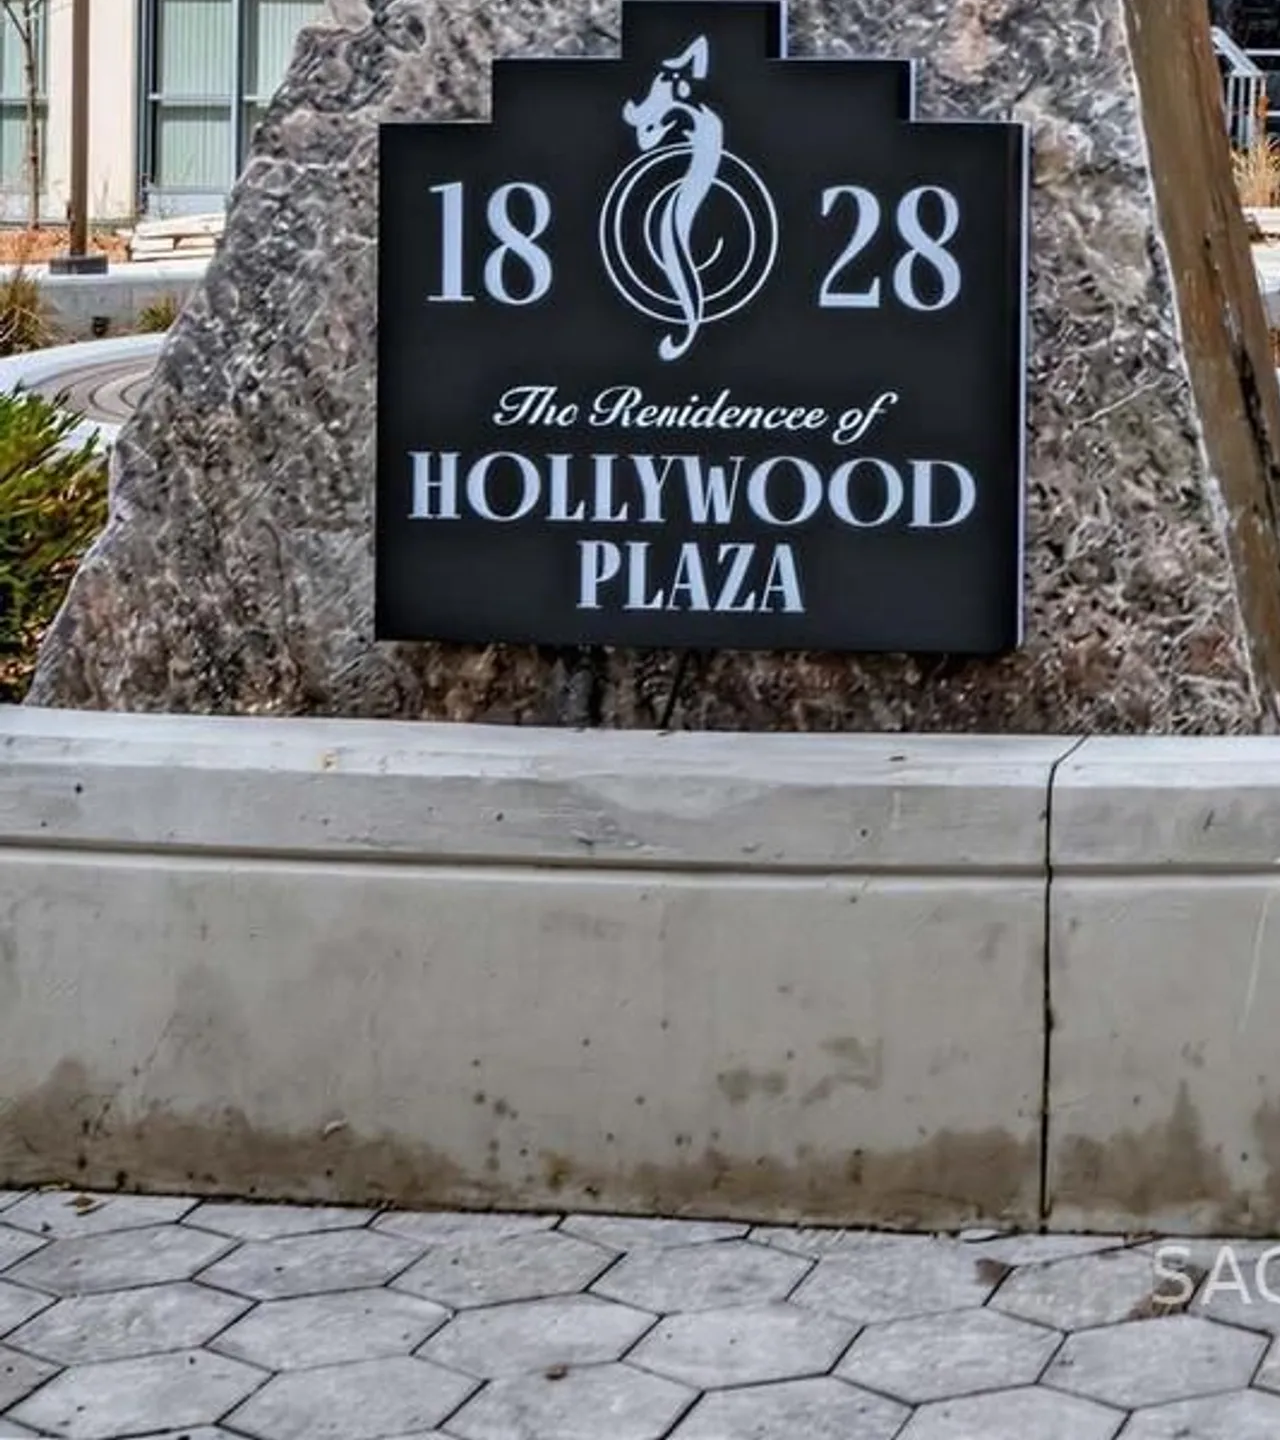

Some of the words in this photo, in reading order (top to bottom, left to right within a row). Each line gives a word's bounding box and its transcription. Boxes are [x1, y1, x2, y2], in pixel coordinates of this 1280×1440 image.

[427, 181, 553, 306] 18
[818, 185, 961, 311] 28
[832, 391, 899, 445] of
[408, 451, 976, 528] HOLLYWOOD
[576, 540, 805, 613] PLAZA
